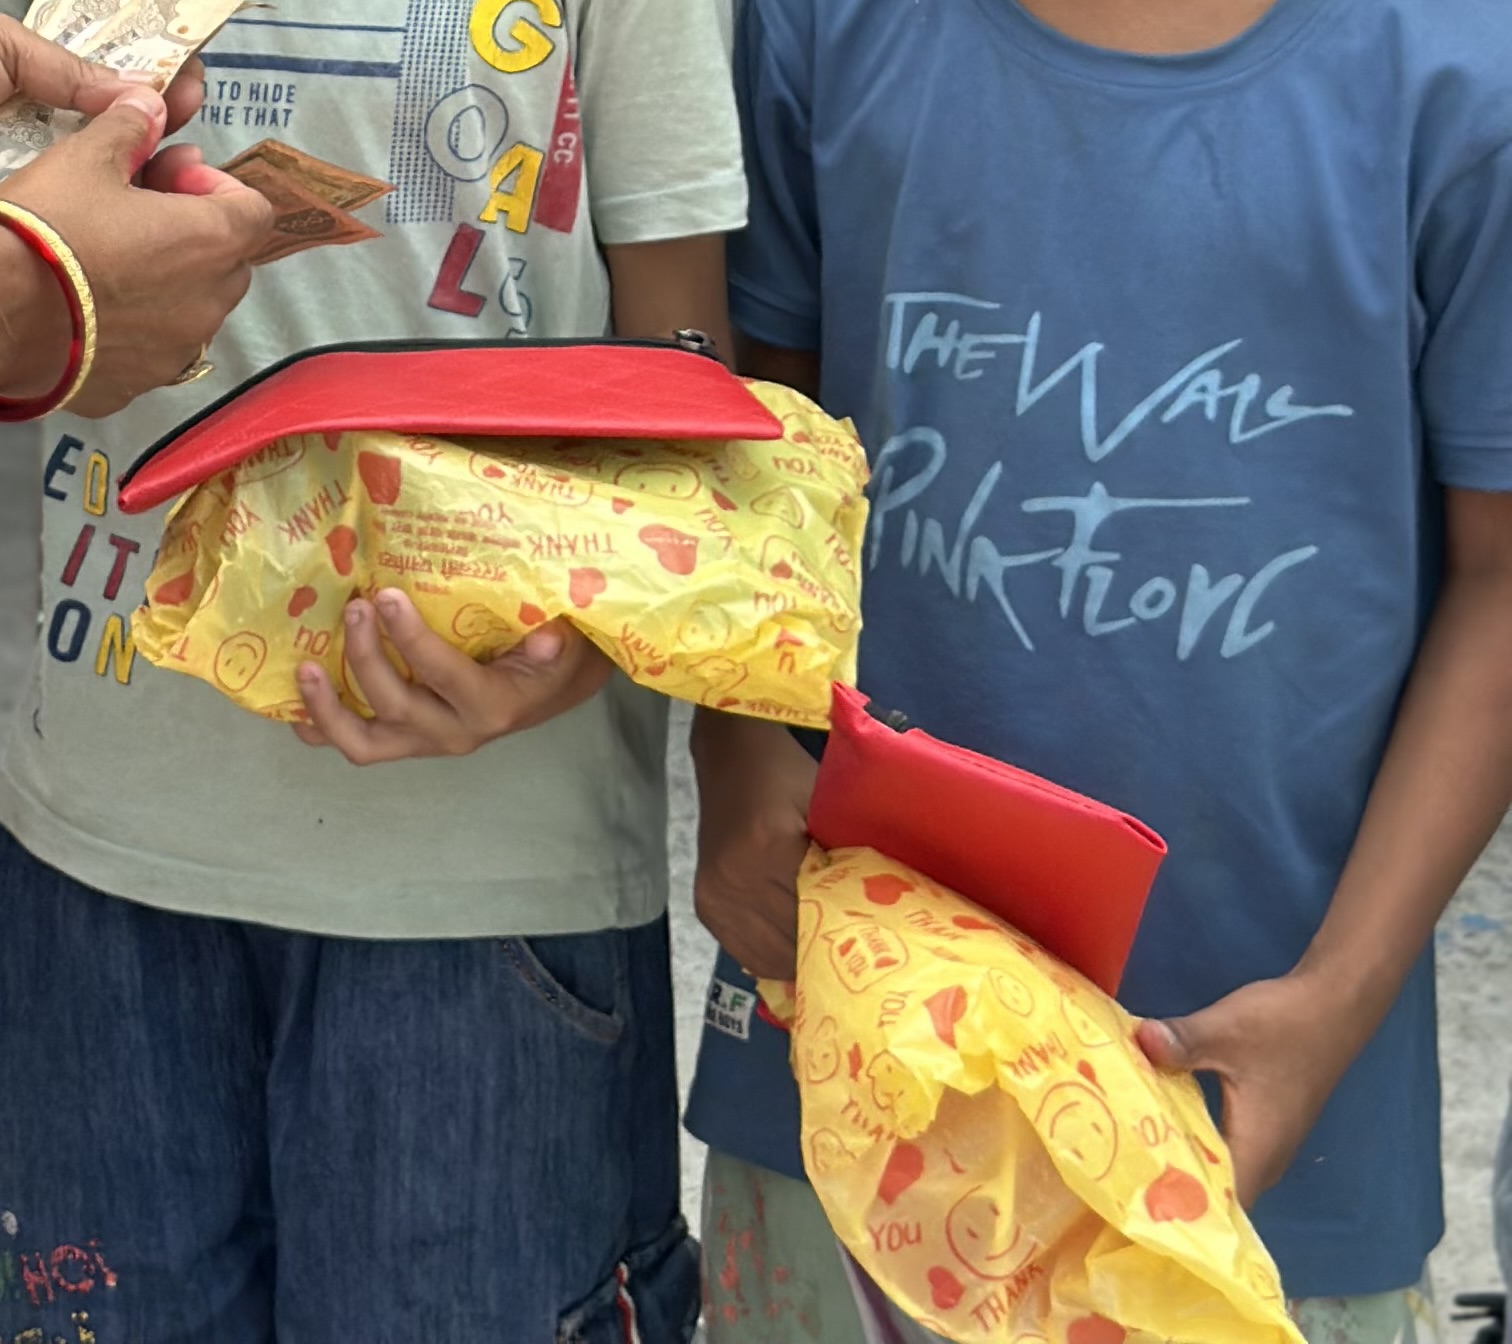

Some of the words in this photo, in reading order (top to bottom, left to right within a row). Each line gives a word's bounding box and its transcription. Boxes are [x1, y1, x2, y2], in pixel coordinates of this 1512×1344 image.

[200, 104, 235, 126] THE
[243, 106, 293, 128] THAT
[217, 80, 241, 101] TO
[249, 82, 297, 104] HIDE
[885, 292, 1024, 380] THE
[277, 478, 351, 544] THANK
[526, 531, 618, 561] THANK
[868, 426, 1064, 651] PINK
[867, 1221, 922, 1253] YOU
[969, 1258, 1045, 1333] THANK
